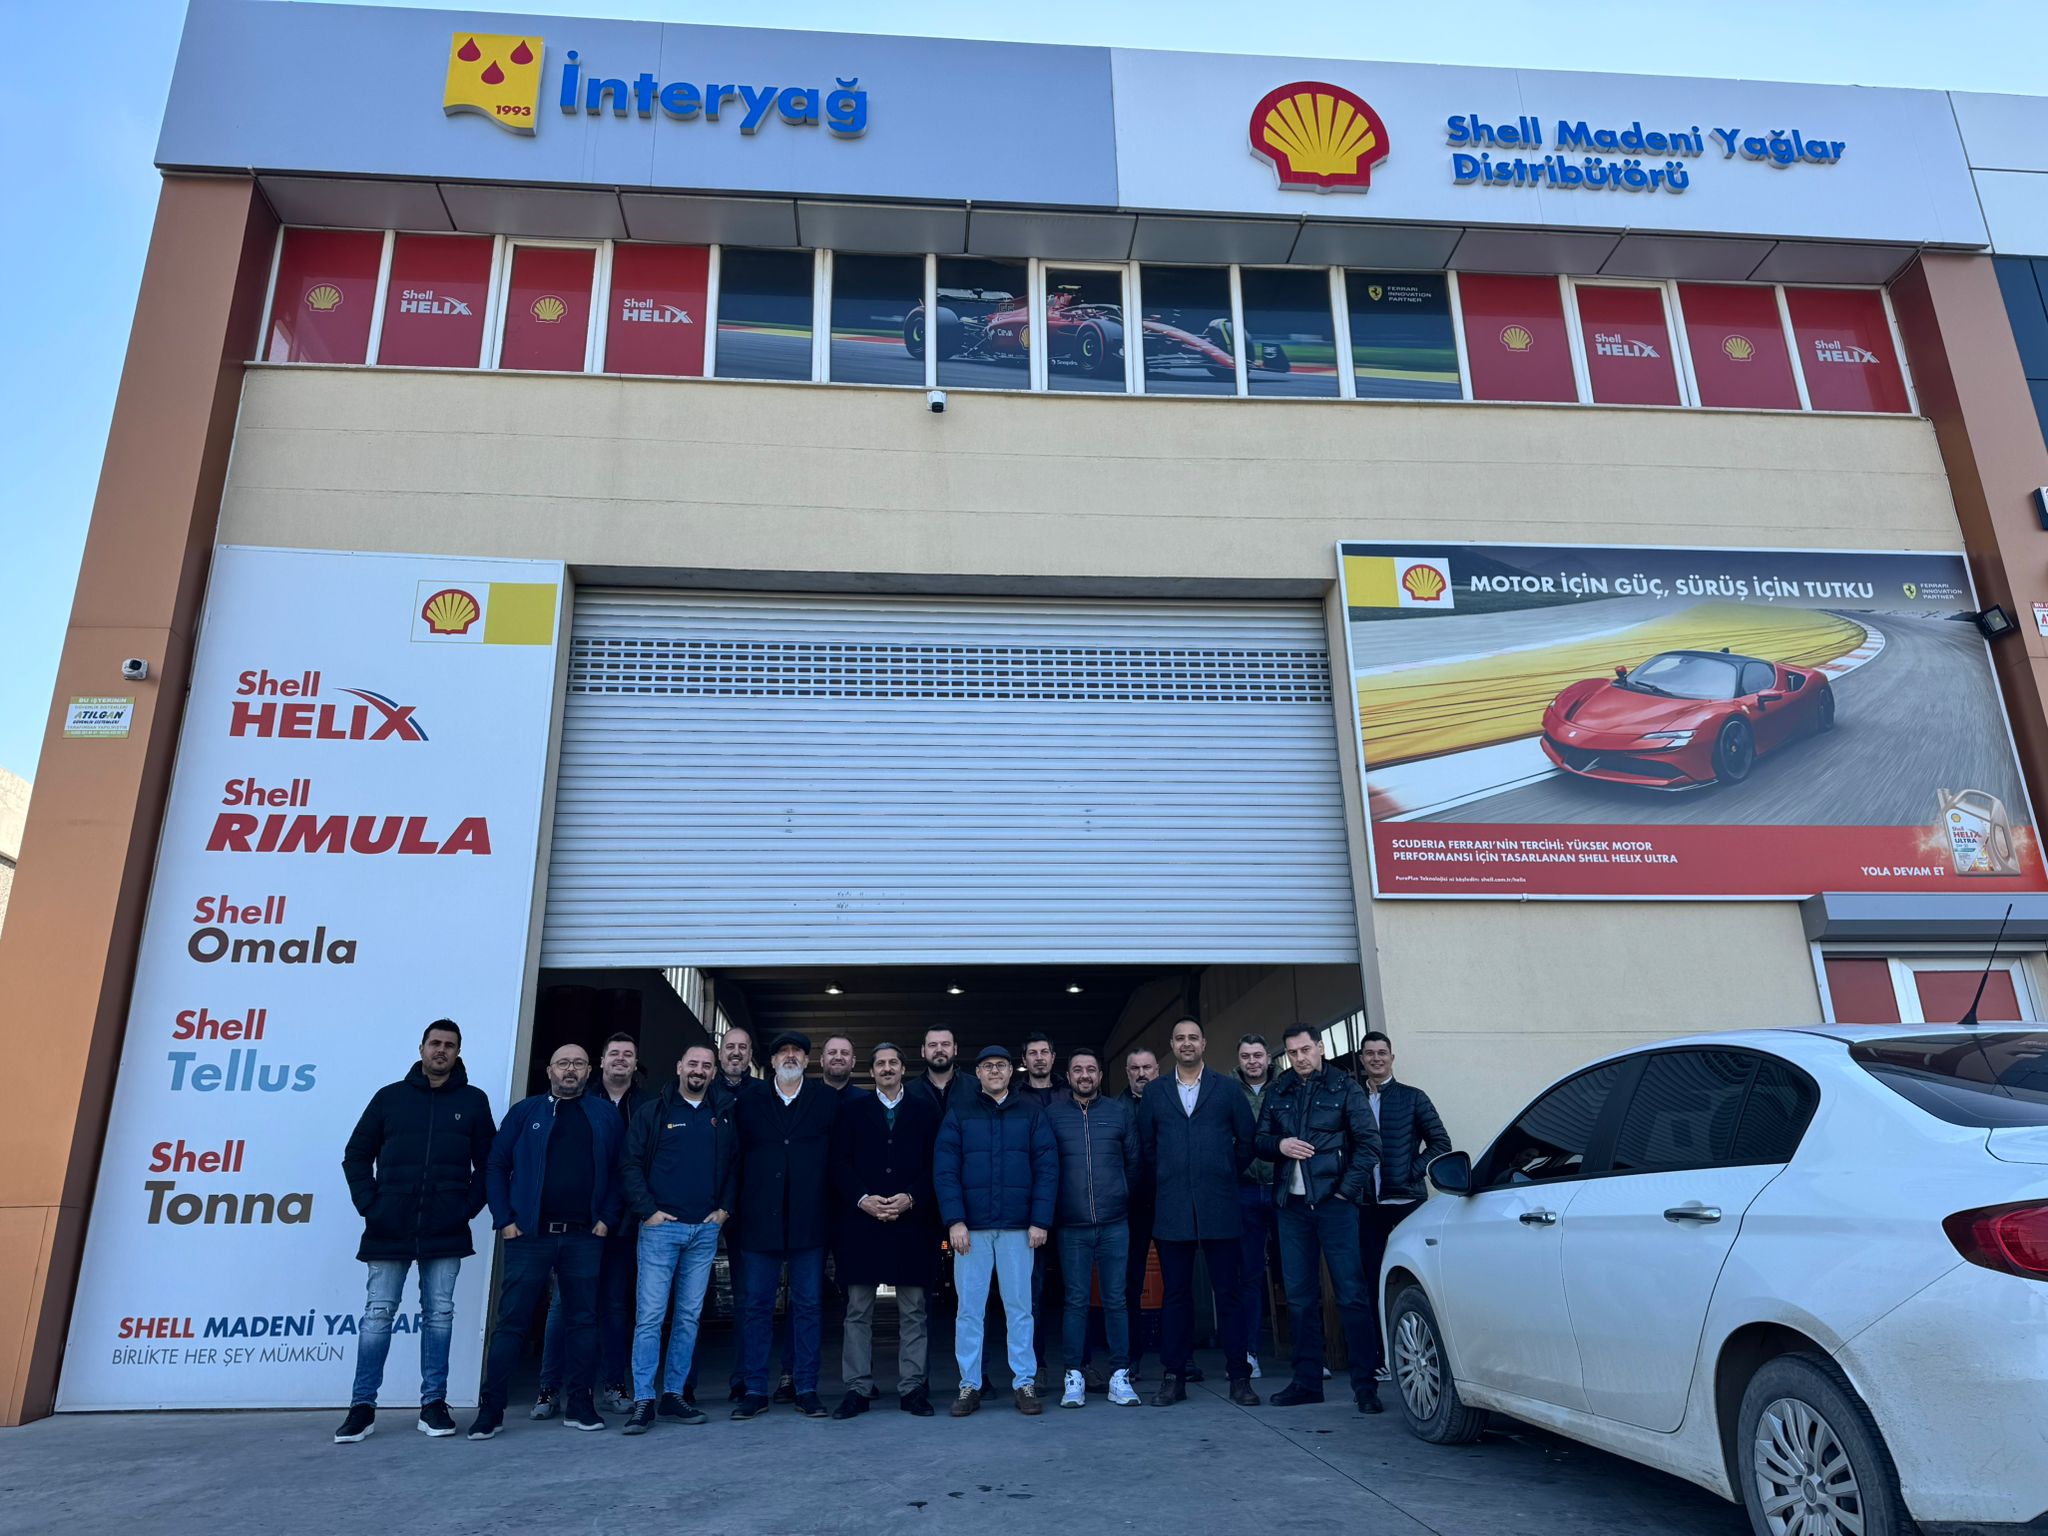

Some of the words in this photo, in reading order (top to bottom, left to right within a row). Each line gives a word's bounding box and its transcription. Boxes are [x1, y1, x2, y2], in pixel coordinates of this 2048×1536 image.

[559, 50, 868, 138] İnteryağ
[494, 104, 531, 118] 1993
[1446, 113, 1543, 149] Shell
[1555, 119, 1704, 157] Madeni
[1708, 127, 1846, 169] Yağlar
[1449, 152, 1690, 194] Distribütörü
[400, 296, 472, 316] HELIX
[402, 290, 433, 301] Shell
[623, 298, 653, 309] Shell
[622, 304, 693, 324] HELIX
[1595, 333, 1621, 344] Shell
[1597, 339, 1660, 358] HELIX
[1815, 340, 1841, 350] Shell
[1816, 345, 1880, 364] HELIX
[1470, 575, 1556, 594] MOTOR
[1561, 571, 1608, 598] İÇİN
[1614, 573, 1670, 599] GÜÇ,
[1675, 574, 1749, 602] SÜRÜŞ
[1754, 575, 1800, 602] İÇİN
[1803, 581, 1874, 599] TUTKU
[236, 669, 321, 697] Shell
[74, 711, 124, 719] ATILGAN
[229, 687, 429, 742] HELIX
[222, 777, 311, 807] Shell
[205, 812, 492, 855] RIMULA
[1392, 839, 1446, 850] SCUDERIA
[1520, 838, 1564, 851] TERCİHİ:
[1566, 838, 1610, 851] YÜKSEK
[1612, 841, 1653, 851] MOTOR
[1953, 829, 1982, 839] HELIX
[1393, 851, 1473, 863] PERFORMANSI
[1475, 851, 1499, 865] İÇİN
[1501, 853, 1576, 864] TASARLANAN
[1578, 854, 1610, 864] SHELL
[1612, 854, 1643, 864] HELIX
[1644, 854, 1679, 865] ULTRA
[1861, 866, 1891, 876] YOLA
[1893, 866, 1932, 877] DEVAM
[1933, 867, 1945, 877] ET
[192, 894, 286, 924] Shell
[187, 926, 357, 964] Omala
[171, 1007, 267, 1040] Shell
[167, 1048, 317, 1092] Tellus
[148, 1139, 245, 1173] Shell
[144, 1180, 314, 1225] Tonna
[118, 1317, 195, 1339] SHELL
[203, 1309, 316, 1338] MADENİ
[323, 1312, 424, 1336] YAAR
[111, 1344, 179, 1366] BİRLİKTE
[183, 1348, 217, 1365] HER
[223, 1346, 256, 1367] ŞEY
[259, 1342, 345, 1364] MÜMKÜN
